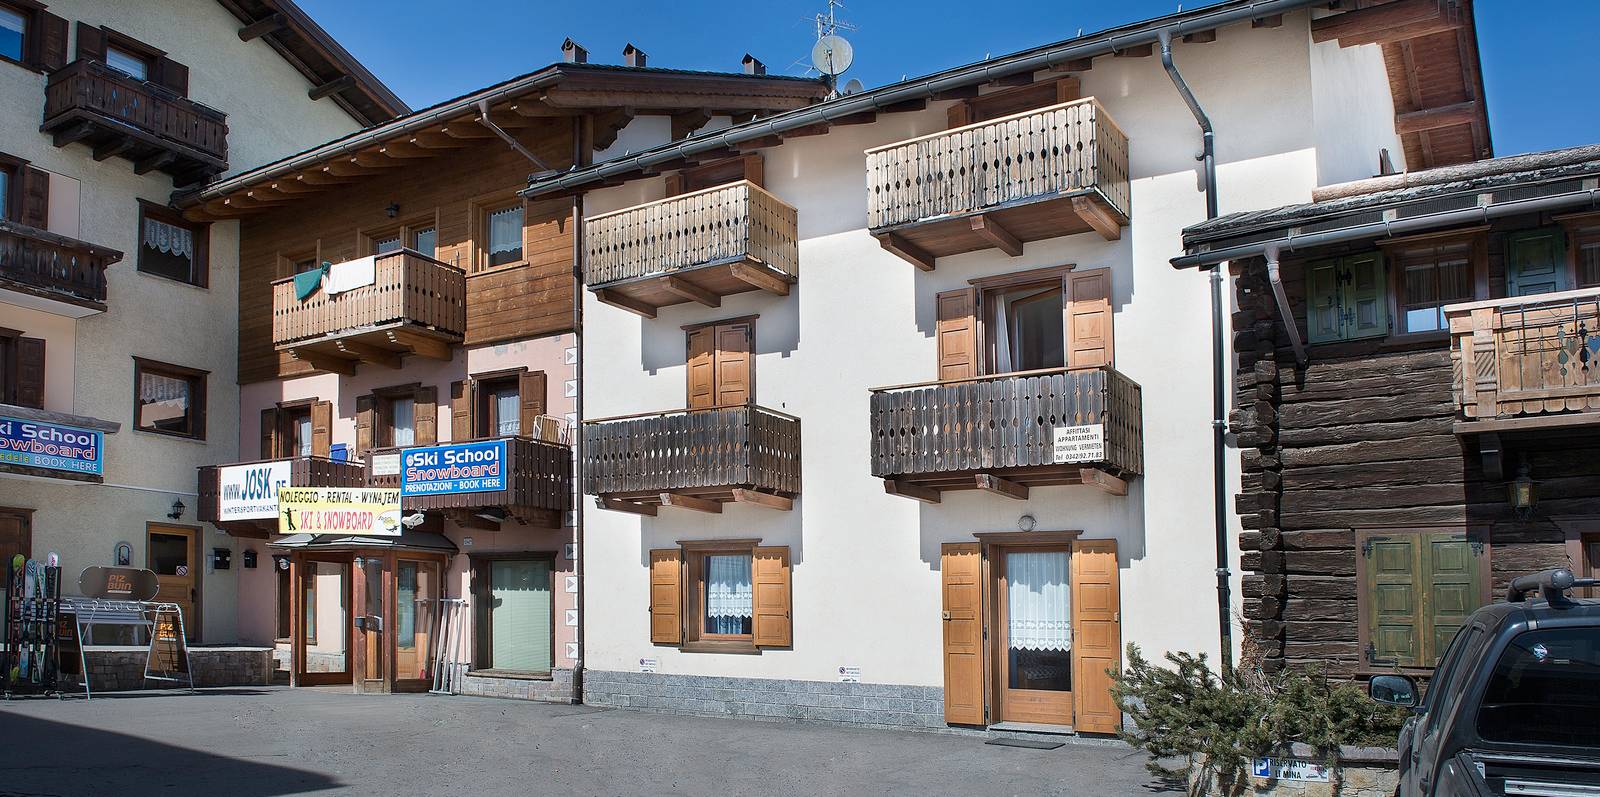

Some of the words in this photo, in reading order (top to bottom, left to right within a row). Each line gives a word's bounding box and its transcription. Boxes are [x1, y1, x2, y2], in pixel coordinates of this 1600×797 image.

[21, 424, 95, 447] School
[1066, 427, 1091, 435] AFFITTASI
[1057, 434, 1100, 443] APPARTAMENTI
[1055, 444, 1078, 452] WOHNUNG
[413, 452, 438, 467] Ski
[444, 446, 499, 465] School
[34, 456, 67, 468] BOOK
[71, 460, 98, 472] HERE
[406, 461, 499, 482] Snowboard
[405, 481, 453, 493] PRENOTAZIONI
[459, 480, 480, 490] BOOK
[482, 478, 501, 488] HERE
[279, 491, 319, 503] NOLEGGIO
[326, 491, 353, 503] RENTAL
[361, 491, 399, 505] WYNAJEM
[300, 511, 314, 530] SKI
[316, 511, 322, 529] &
[323, 511, 373, 530] SNOWBOARD
[1269, 758, 1307, 768] RISERVATO
[1282, 770, 1302, 779] MINA
